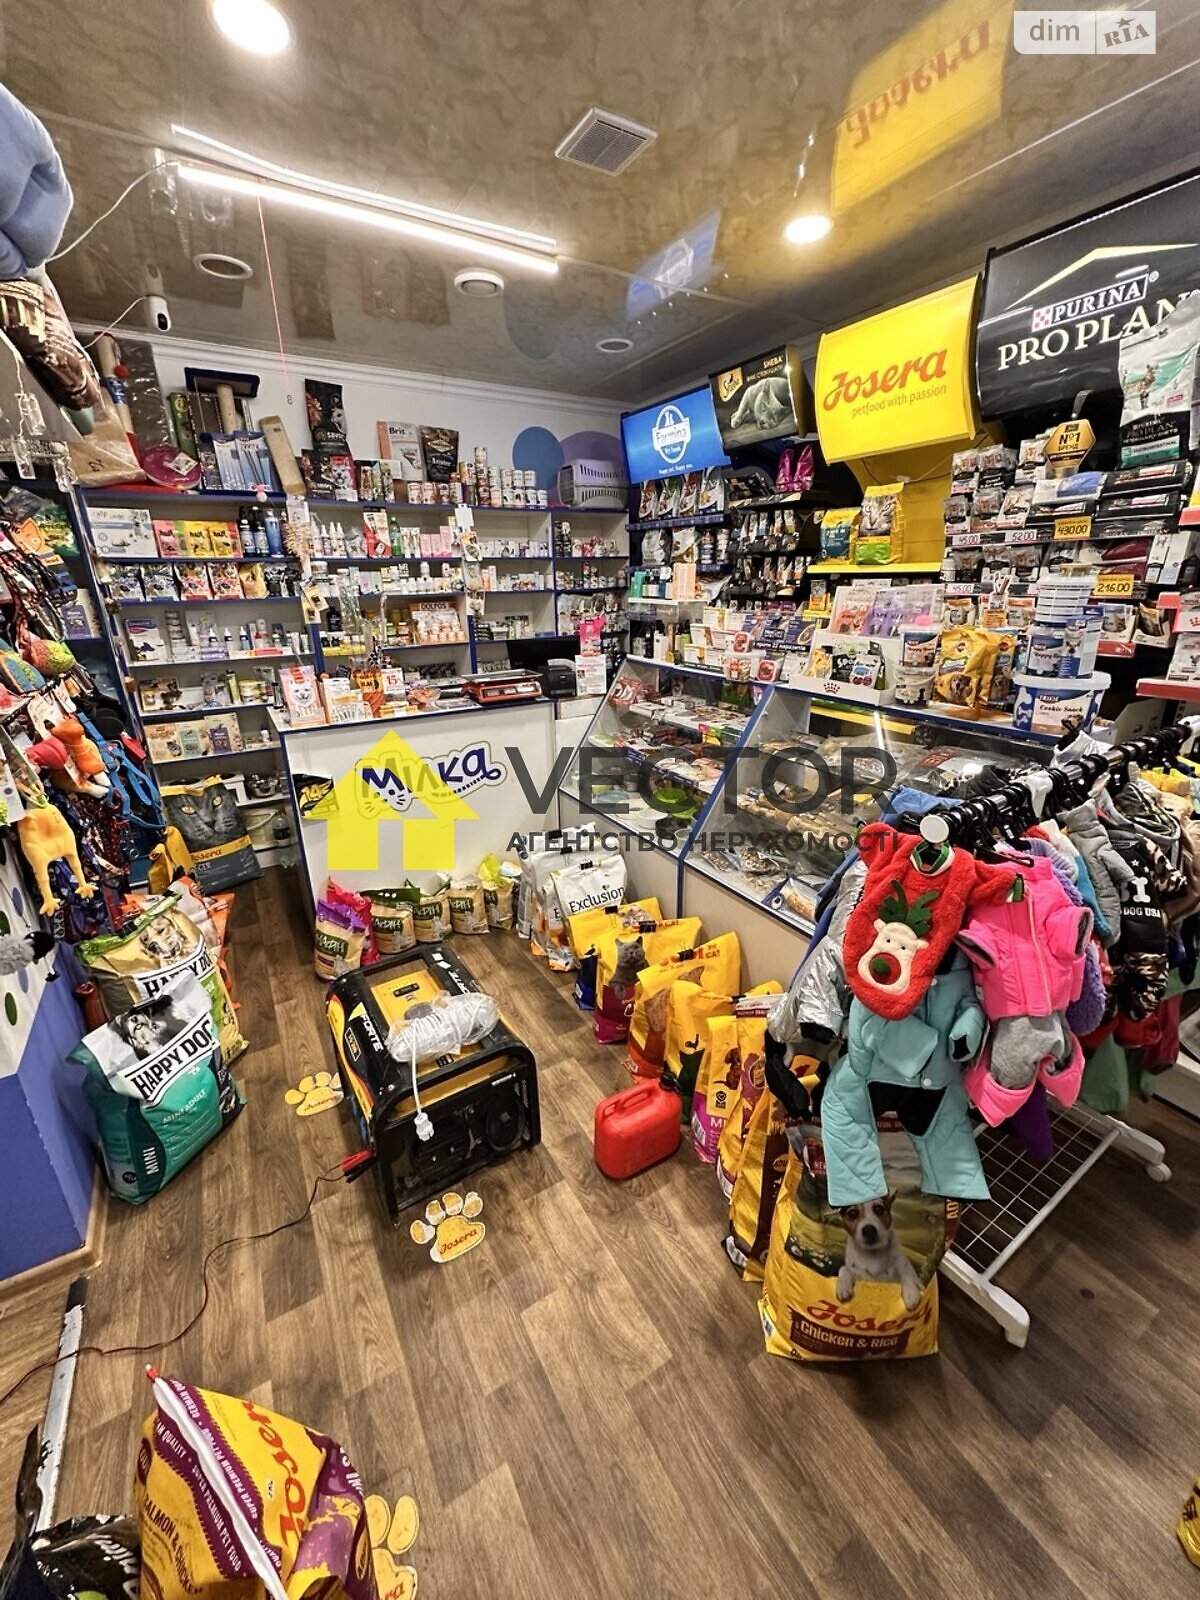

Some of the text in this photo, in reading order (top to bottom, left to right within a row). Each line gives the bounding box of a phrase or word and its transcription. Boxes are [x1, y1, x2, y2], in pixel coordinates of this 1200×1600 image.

[1053, 281, 1141, 322] PURINA
[997, 329, 1070, 370] PRO
[823, 349, 948, 411] Josera
[852, 385, 947, 418] petfood with passion
[389, 427, 405, 435] Brit
[568, 886, 624, 913] Exclusion
[1123, 906, 1161, 918] DOG USA
[360, 1014, 384, 1052] FORTE
[131, 1049, 183, 1100] HAPPY
[184, 1089, 206, 1110] ADULT
[143, 1146, 159, 1175] MINI
[439, 1228, 478, 1256] Josera
[807, 1299, 932, 1332] Josera
[856, 1338, 868, 1349] &
[183, 1392, 200, 1418] GERMAN
[222, 1463, 245, 1500] PREMIUM
[163, 1430, 241, 1572] QUALITY SUPER PREMIUM PET FOOD
